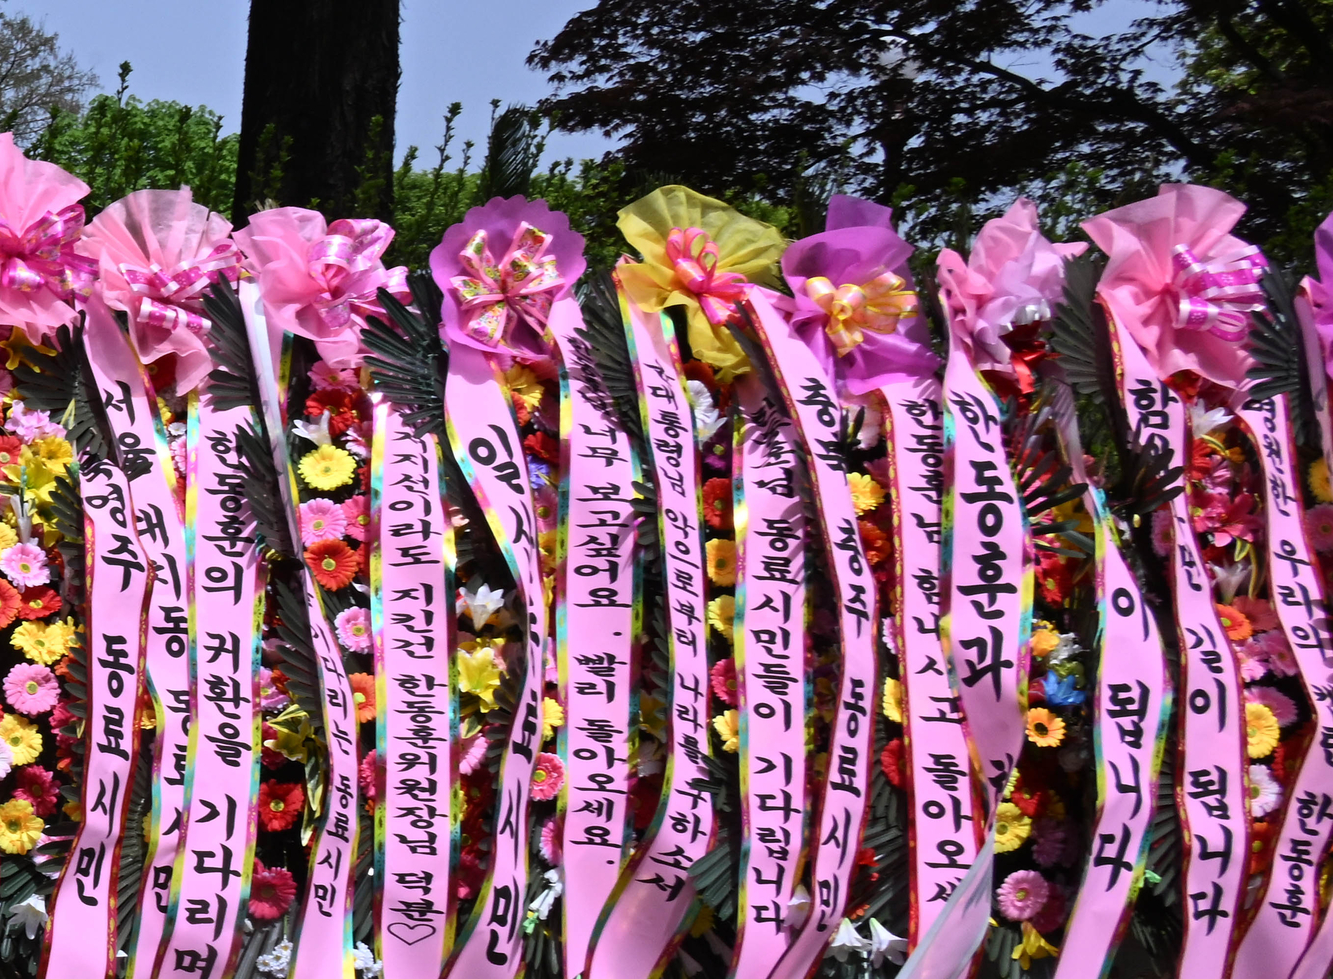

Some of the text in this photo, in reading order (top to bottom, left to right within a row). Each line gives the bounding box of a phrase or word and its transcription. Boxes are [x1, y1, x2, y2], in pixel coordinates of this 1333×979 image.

[577, 422, 630, 468] 너무
[201, 430, 255, 607] 한동훈의
[832, 517, 869, 639] 충주
[950, 389, 1018, 703] 한동훈과
[573, 651, 629, 704] 빨리
[750, 518, 801, 733] 동료시민들이
[1185, 623, 1228, 733] 길이
[202, 631, 252, 768] 귀환을
[675, 671, 707, 765] 나라를
[634, 775, 710, 903] 구하소서
[750, 752, 802, 936] 기다립니다
[1092, 679, 1152, 893] 됩니다
[1187, 763, 1233, 936] 됩니다
[388, 869, 446, 923] 덕분
[1268, 789, 1333, 929] 한동훈
